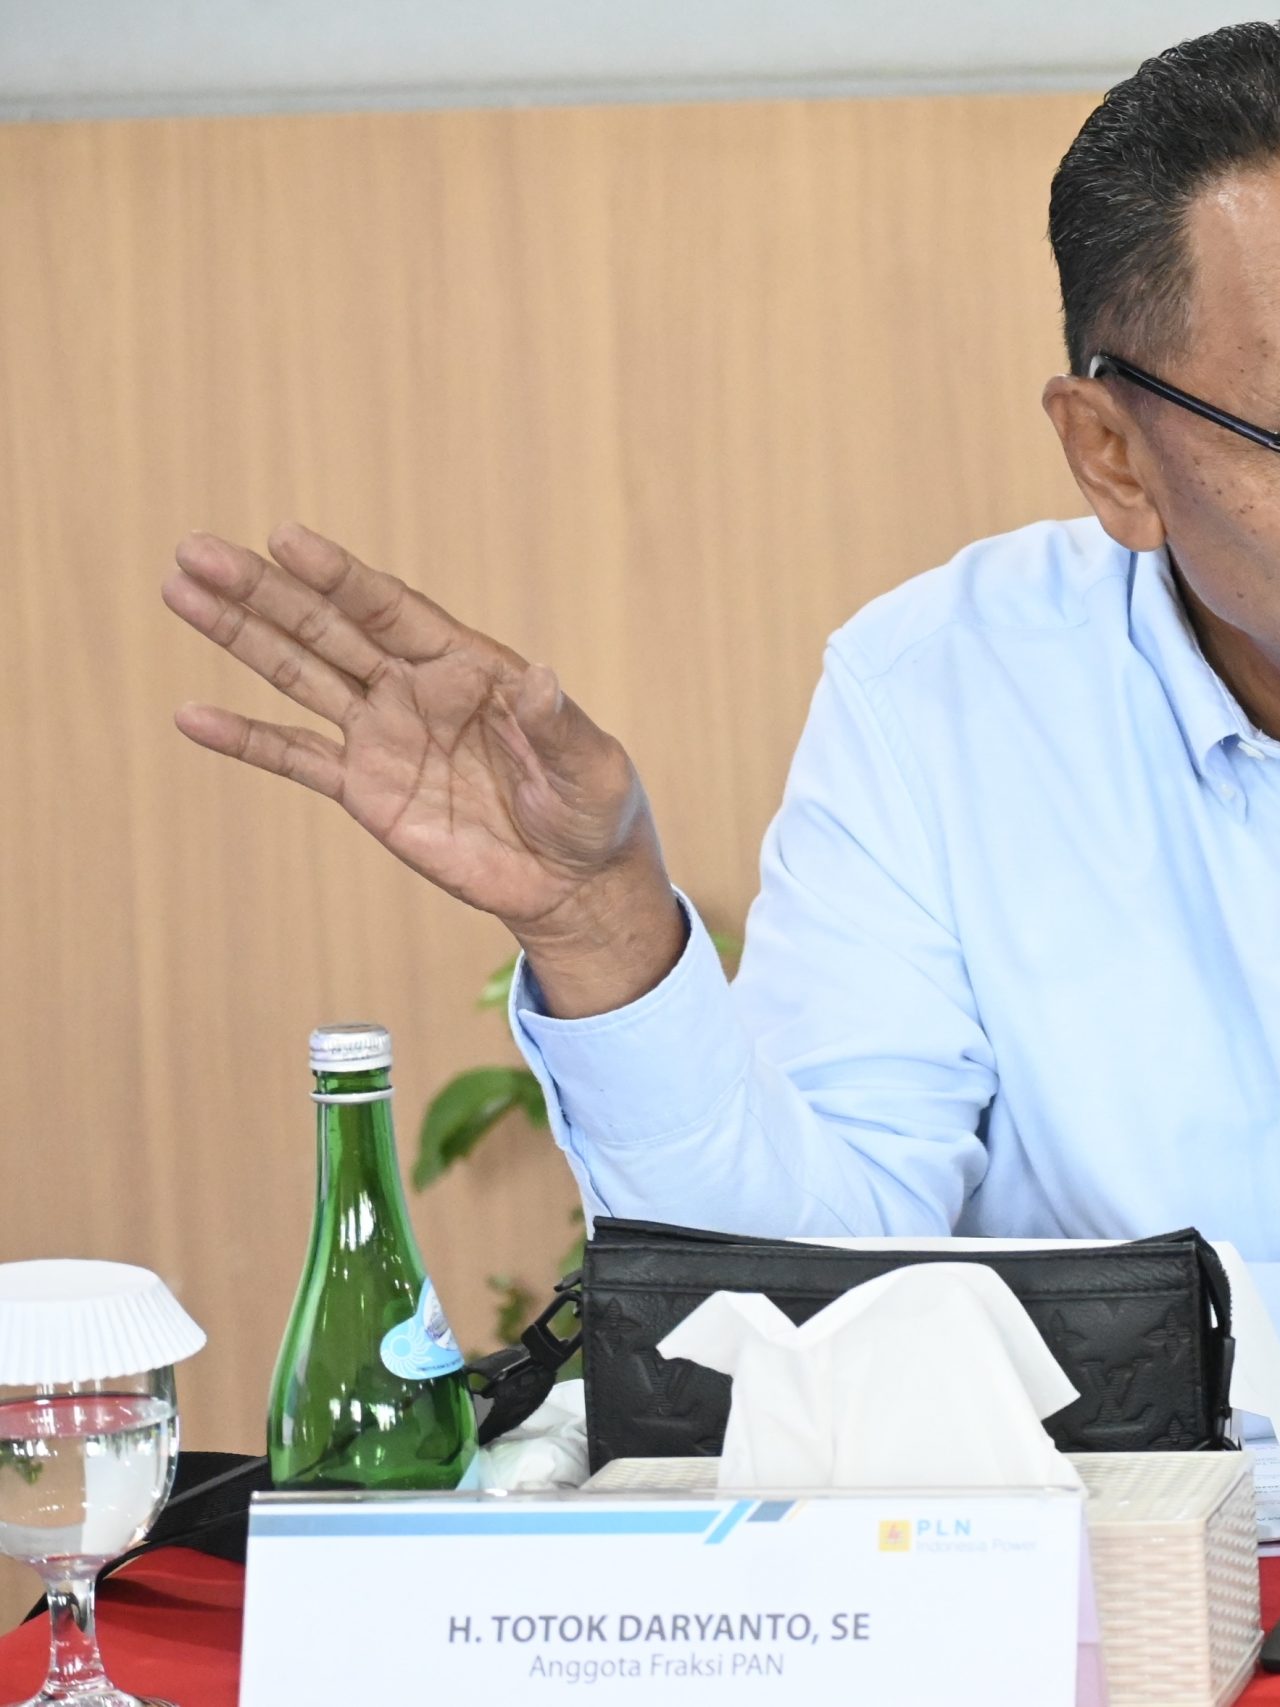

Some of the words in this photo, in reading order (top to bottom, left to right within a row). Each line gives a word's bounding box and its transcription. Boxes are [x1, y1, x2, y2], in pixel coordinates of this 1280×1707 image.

[916, 1519, 971, 1537] PLN
[449, 1616, 482, 1643] H.
[491, 1615, 608, 1643] TOTOK
[618, 1613, 819, 1644] DARYANTO,
[831, 1613, 870, 1641] SE
[529, 1654, 641, 1684] Anggota
[650, 1652, 723, 1677] Fraksi
[732, 1653, 784, 1676] PAN
